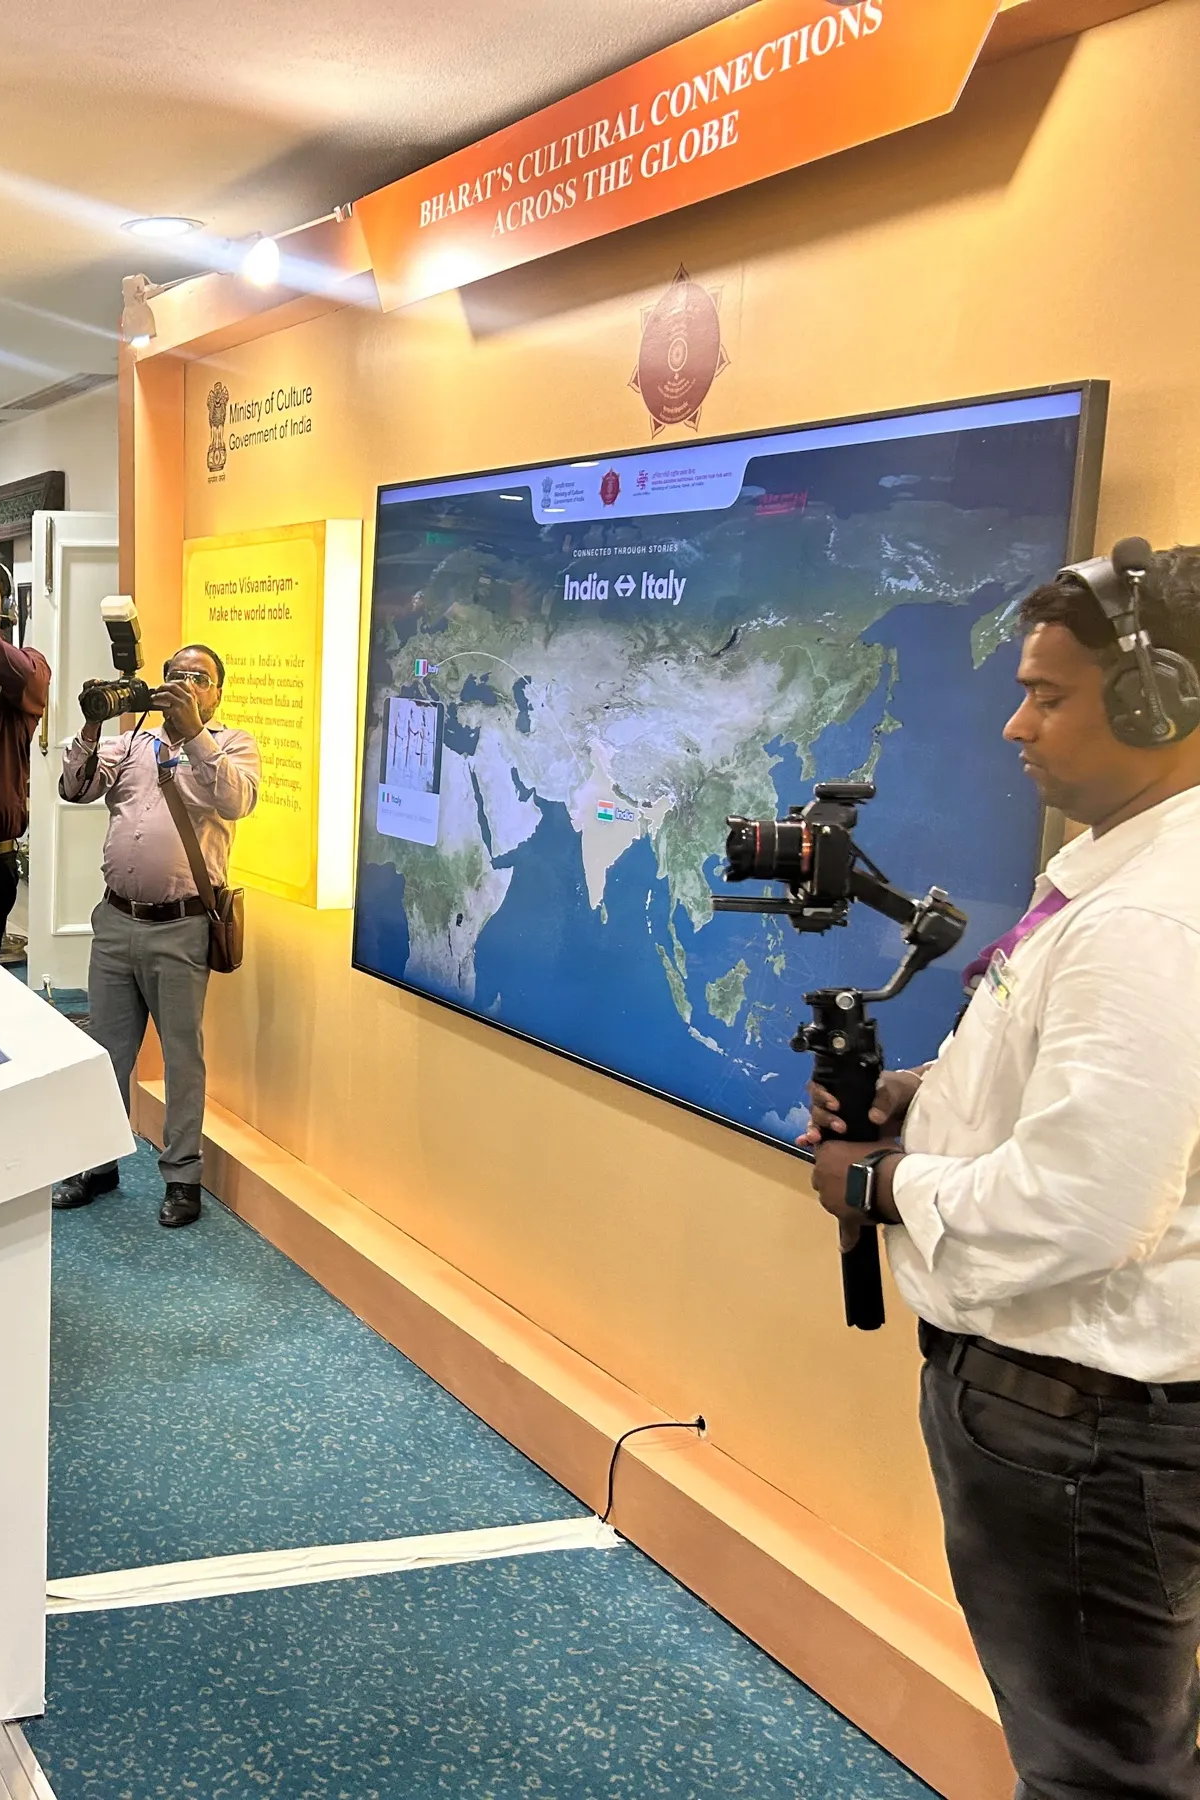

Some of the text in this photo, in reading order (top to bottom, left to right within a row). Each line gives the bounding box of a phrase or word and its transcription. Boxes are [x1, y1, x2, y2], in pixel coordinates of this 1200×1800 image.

[419, 0, 884, 228] BHARAT'S CULTURAL CONNECTIONS
[491, 109, 739, 238] ACROSS THE GLOBE
[229, 386, 312, 424] Ministry of Culture
[229, 415, 312, 450] Government of India
[573, 544, 679, 557] CONNECTED THROUGH STORIES
[564, 569, 687, 606] India Italy
[209, 603, 293, 621] Make the world noble.
[225, 653, 247, 666] Bharat
[250, 655, 255, 666] is
[285, 654, 305, 668] wider
[228, 672, 304, 689] sphere shaped by centuries
[224, 691, 303, 709] exchange between India and
[227, 709, 253, 725] recognises
[255, 711, 263, 724] the
[265, 715, 295, 728] movement
[296, 716, 303, 729] of
[274, 737, 302, 751] systems,
[275, 755, 302, 769] practices
